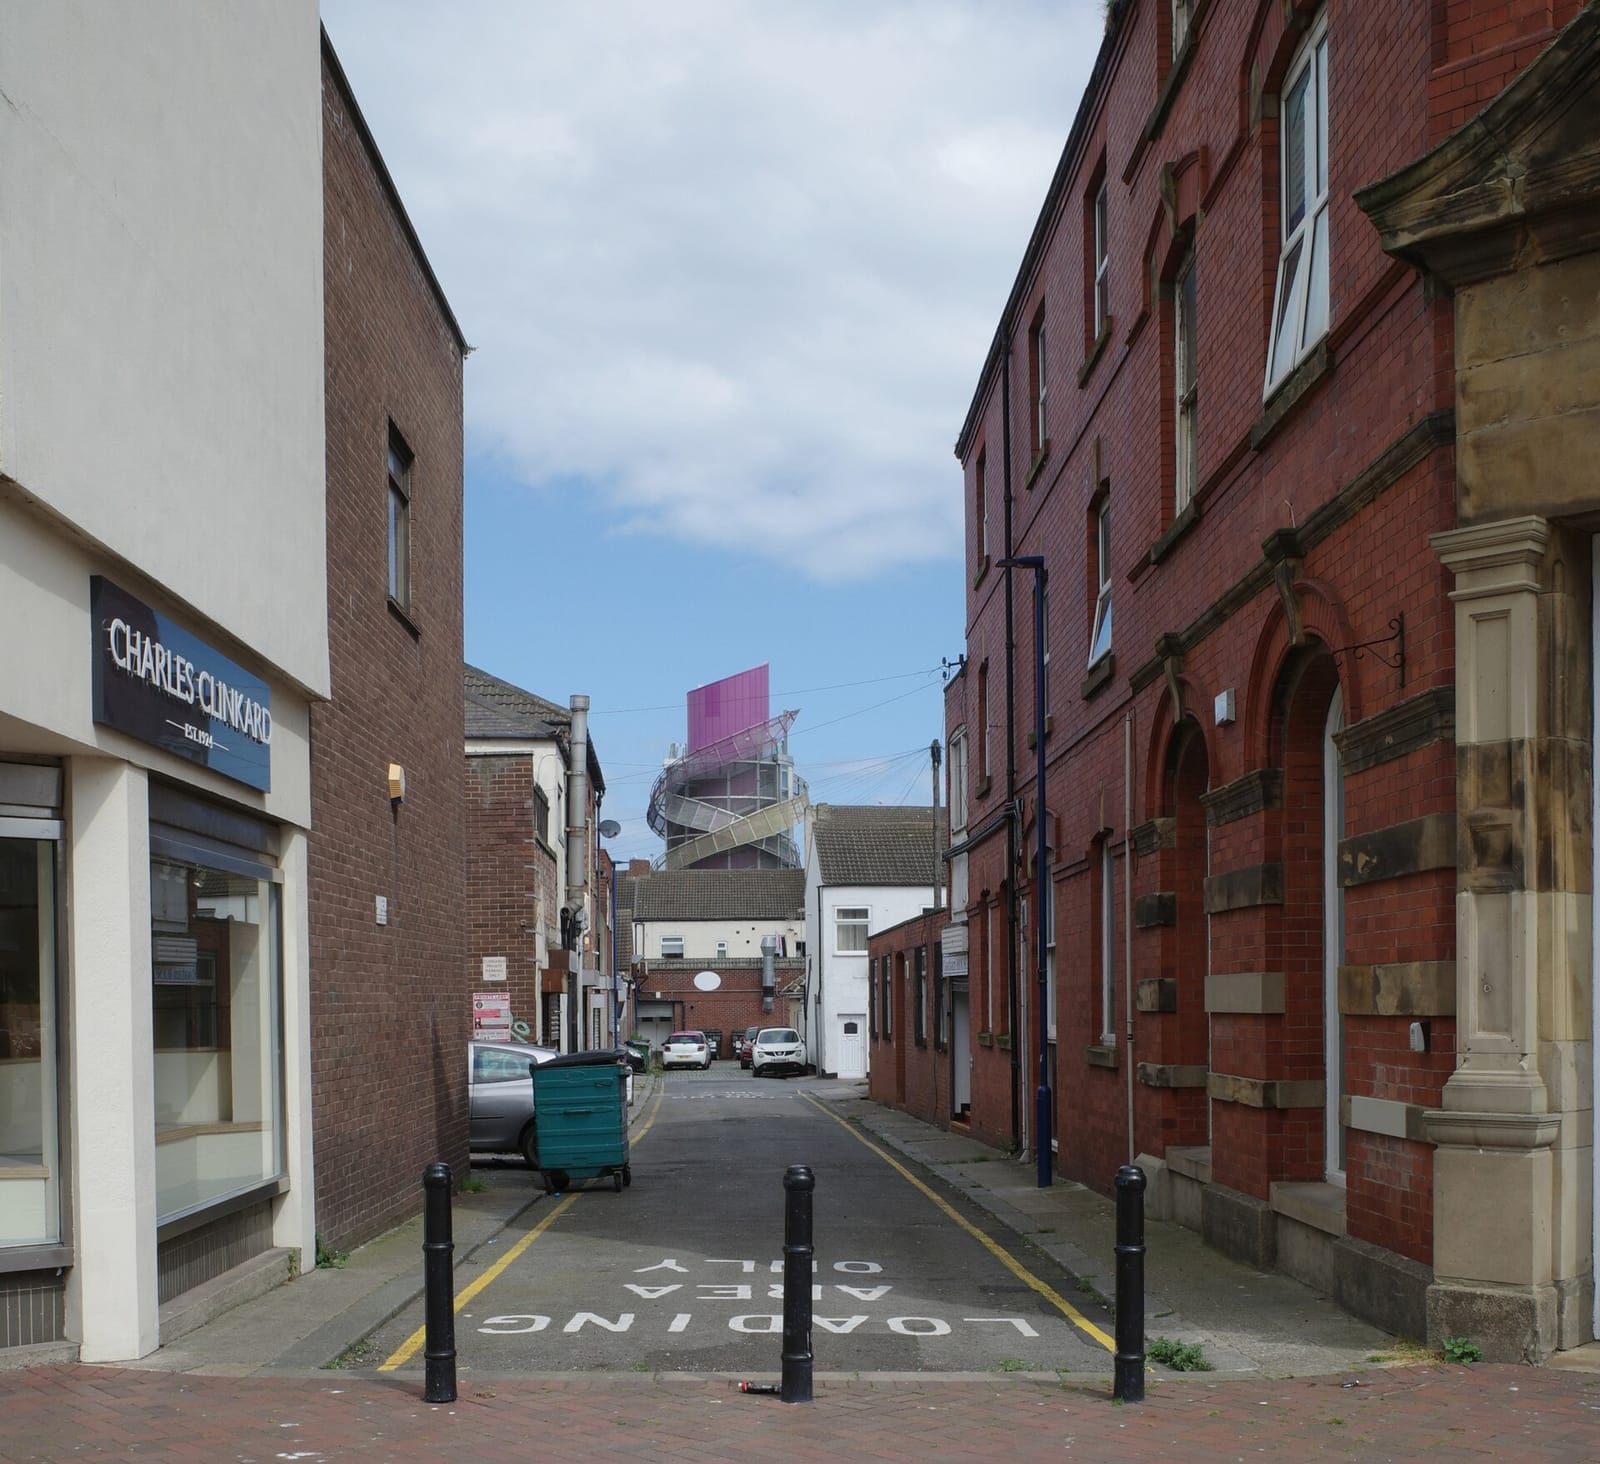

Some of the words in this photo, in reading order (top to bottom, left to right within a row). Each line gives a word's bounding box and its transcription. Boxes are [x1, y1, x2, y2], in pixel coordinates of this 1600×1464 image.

[110, 618, 194, 704] CHARLES
[199, 671, 272, 744] CLINKARD
[477, 1312, 1040, 1337] LOADING
